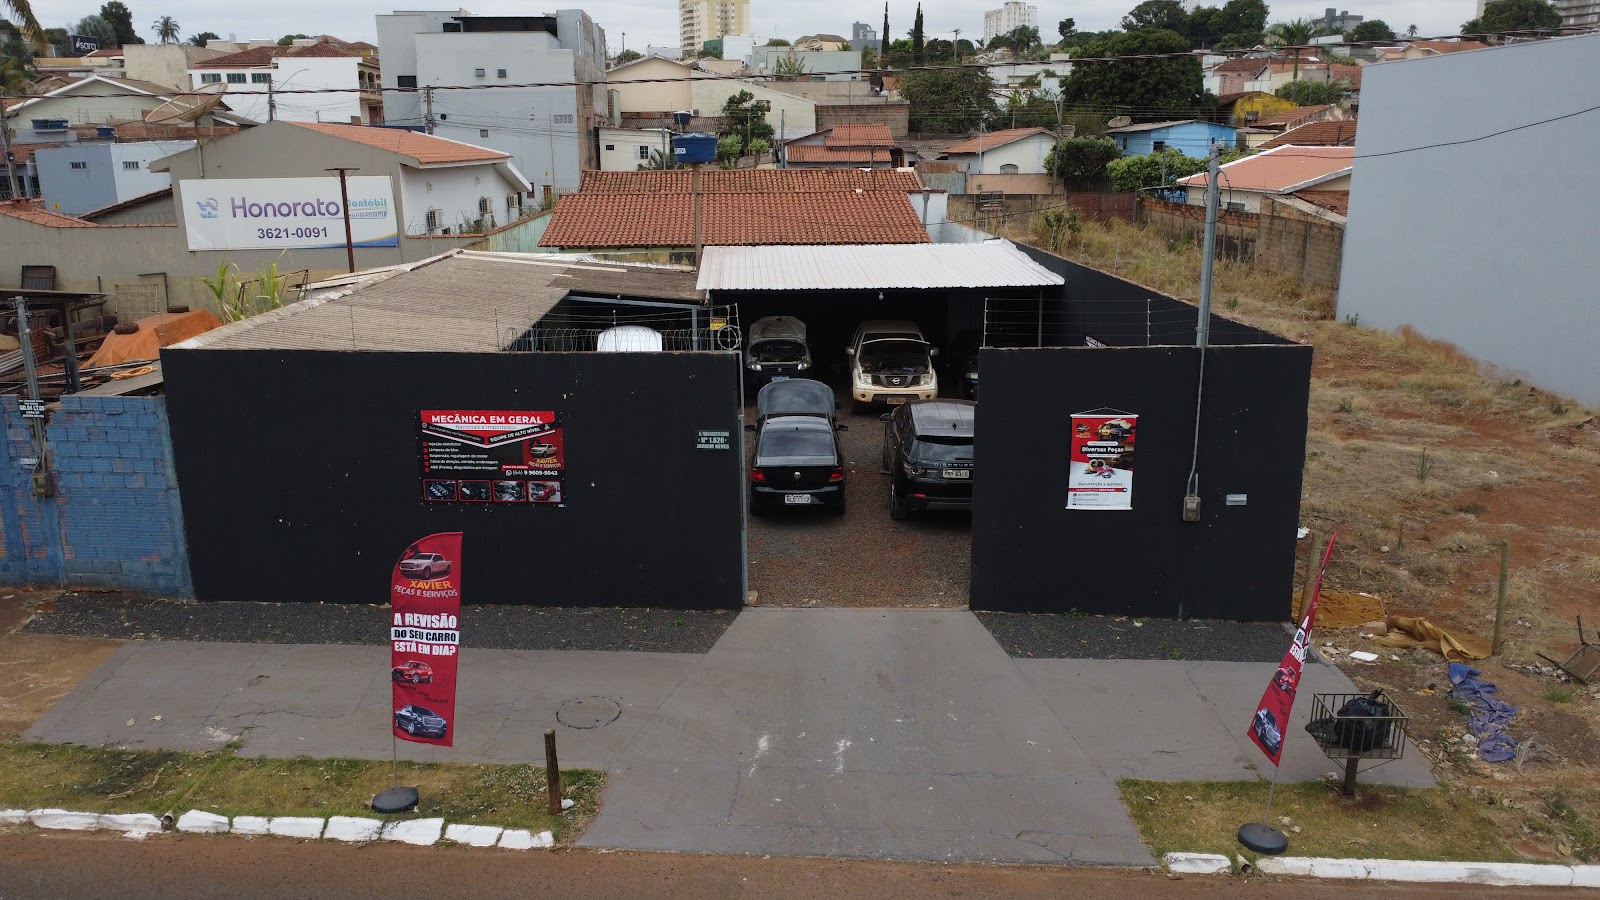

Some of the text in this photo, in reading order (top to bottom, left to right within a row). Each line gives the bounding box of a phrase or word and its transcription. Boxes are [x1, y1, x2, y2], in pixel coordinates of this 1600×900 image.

[230, 196, 341, 218] Honorato
[257, 227, 328, 239] 3621-0091
[431, 414, 487, 423] MECÂNICA
[509, 416, 543, 424] GERAL
[514, 429, 527, 437] ALTO
[394, 585, 415, 596] PEÇAS
[422, 589, 458, 598] SERVIÇOS
[409, 580, 452, 590] XAVIER
[393, 613, 457, 628] A REVISÃO
[394, 629, 457, 642] DO SEU CARRO
[394, 640, 456, 656] ESTÁ EM DIA?
